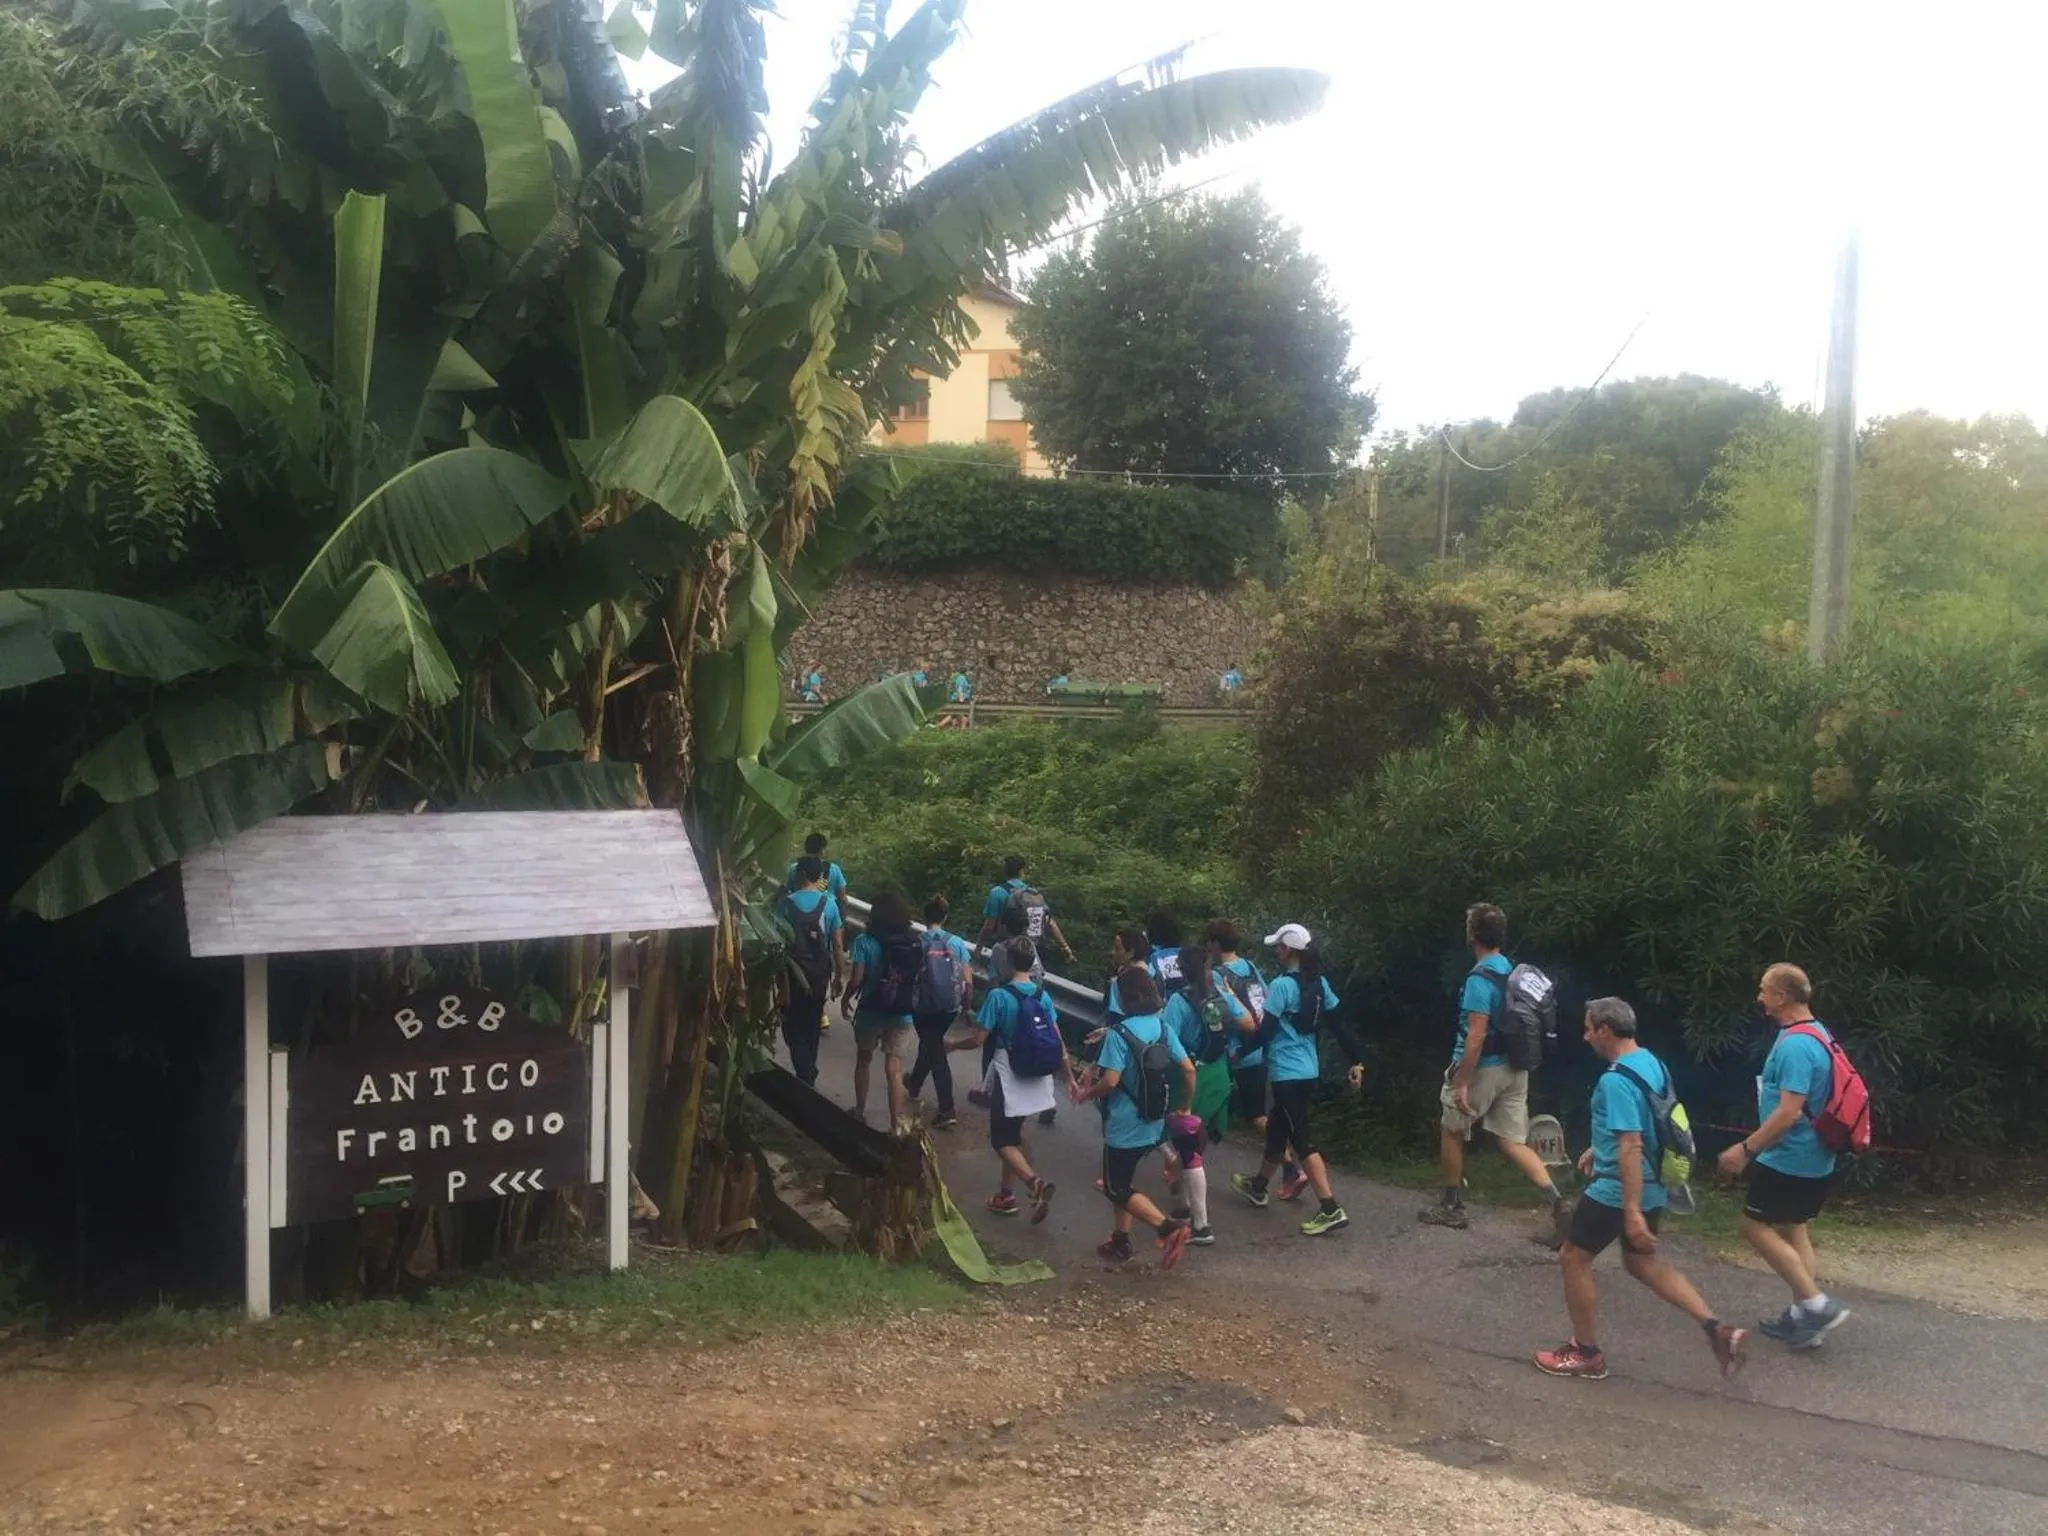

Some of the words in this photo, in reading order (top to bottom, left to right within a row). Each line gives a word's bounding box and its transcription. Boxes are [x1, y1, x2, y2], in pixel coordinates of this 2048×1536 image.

[353, 1059, 539, 1105] ANTICO
[337, 1112, 565, 1161] Frantoio
[448, 1170, 467, 1203] P
